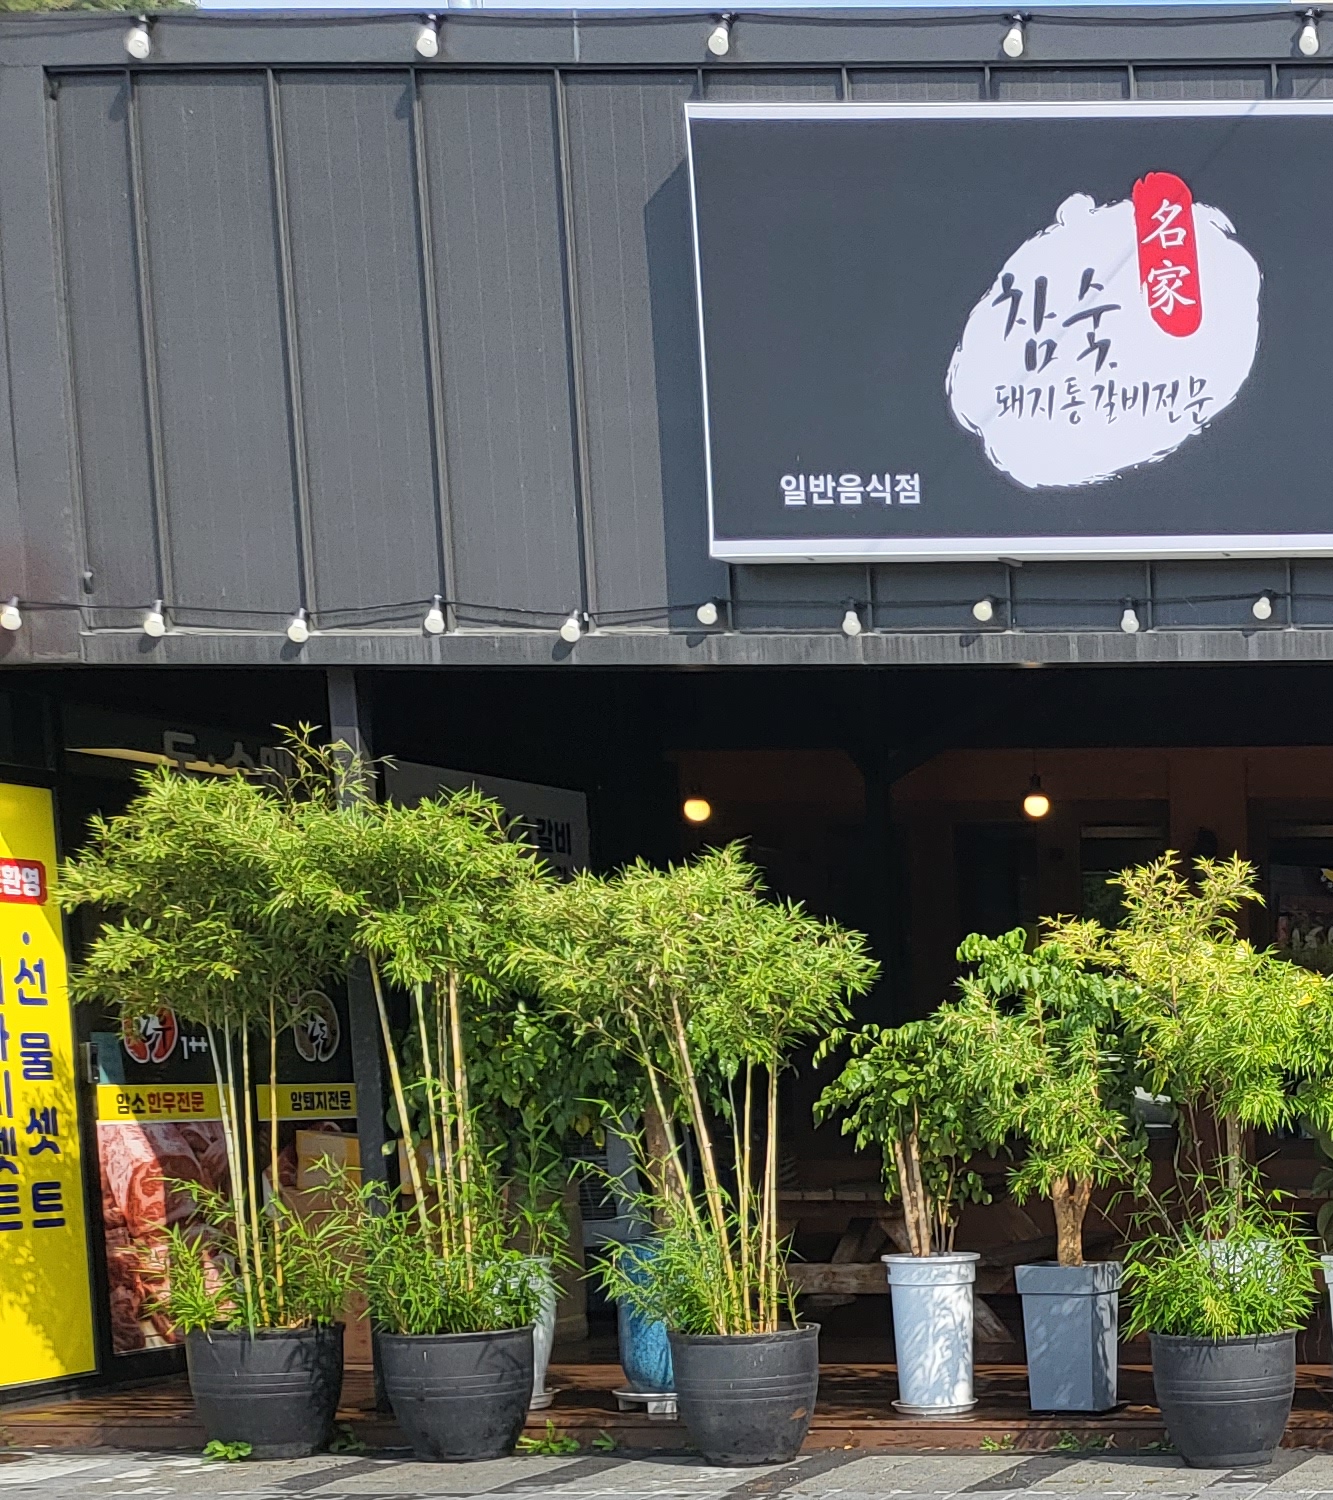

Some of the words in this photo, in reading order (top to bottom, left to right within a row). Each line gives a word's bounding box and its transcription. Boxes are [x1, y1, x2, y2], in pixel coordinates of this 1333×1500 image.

[1140, 199, 1197, 315] 名家
[991, 267, 1122, 374] 참숯
[994, 375, 1214, 425] 돼지통갈비전문
[779, 472, 922, 506] 일반음식점
[0, 864, 41, 897] 환영
